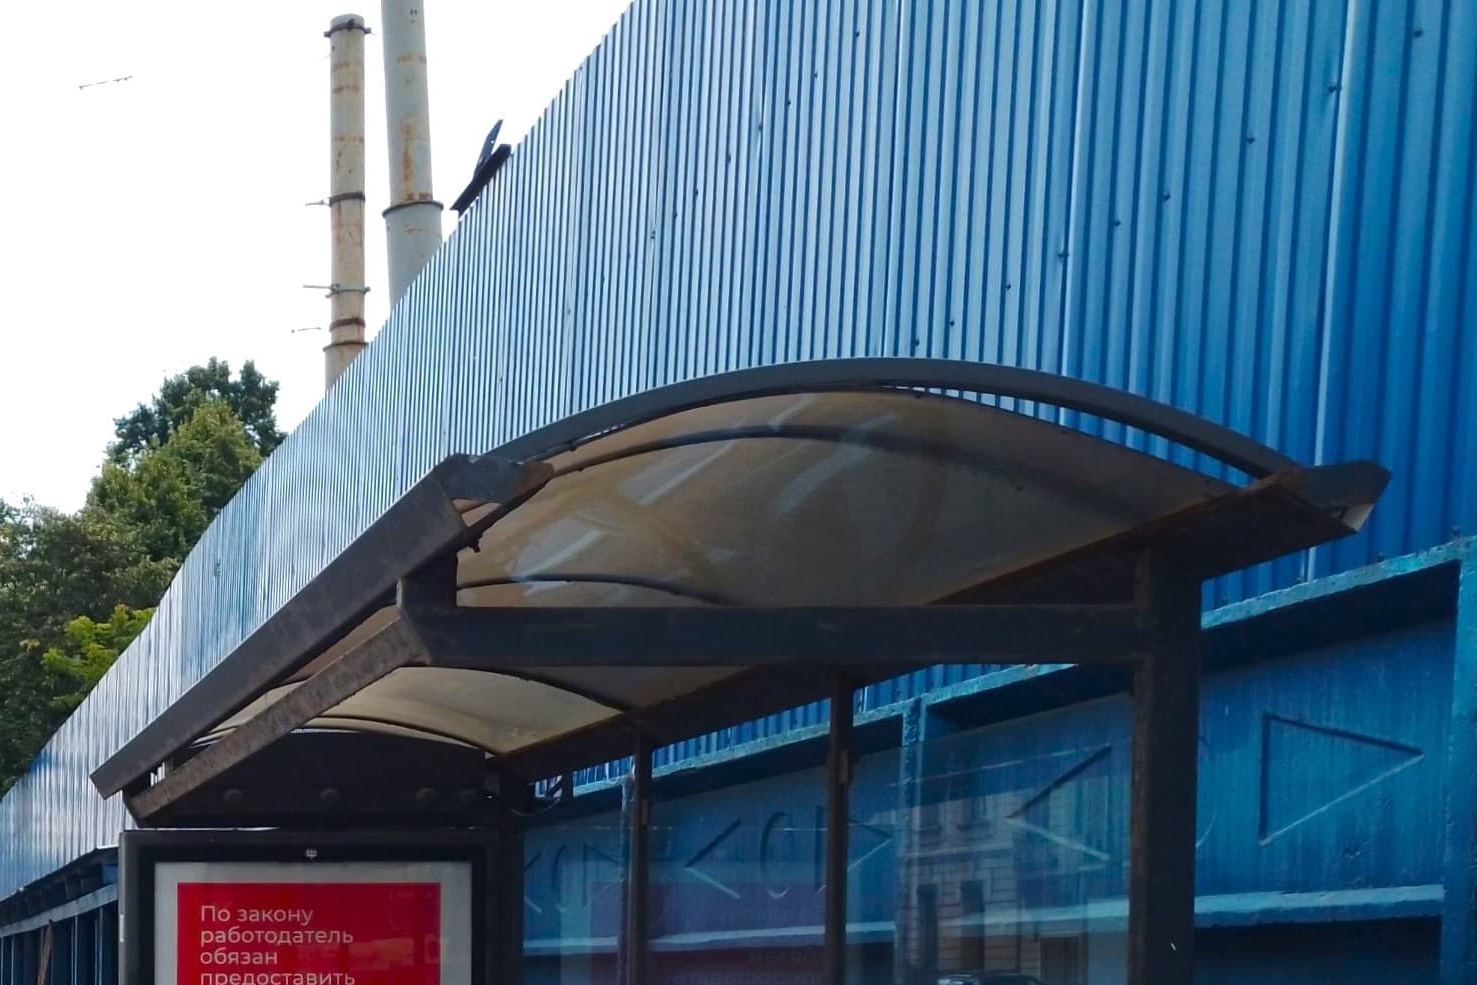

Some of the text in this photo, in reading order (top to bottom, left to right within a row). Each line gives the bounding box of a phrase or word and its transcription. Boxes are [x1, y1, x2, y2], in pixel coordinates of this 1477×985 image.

[201, 906, 313, 925] По закону
[200, 926, 353, 946] работодатель
[200, 948, 278, 965] обязан
